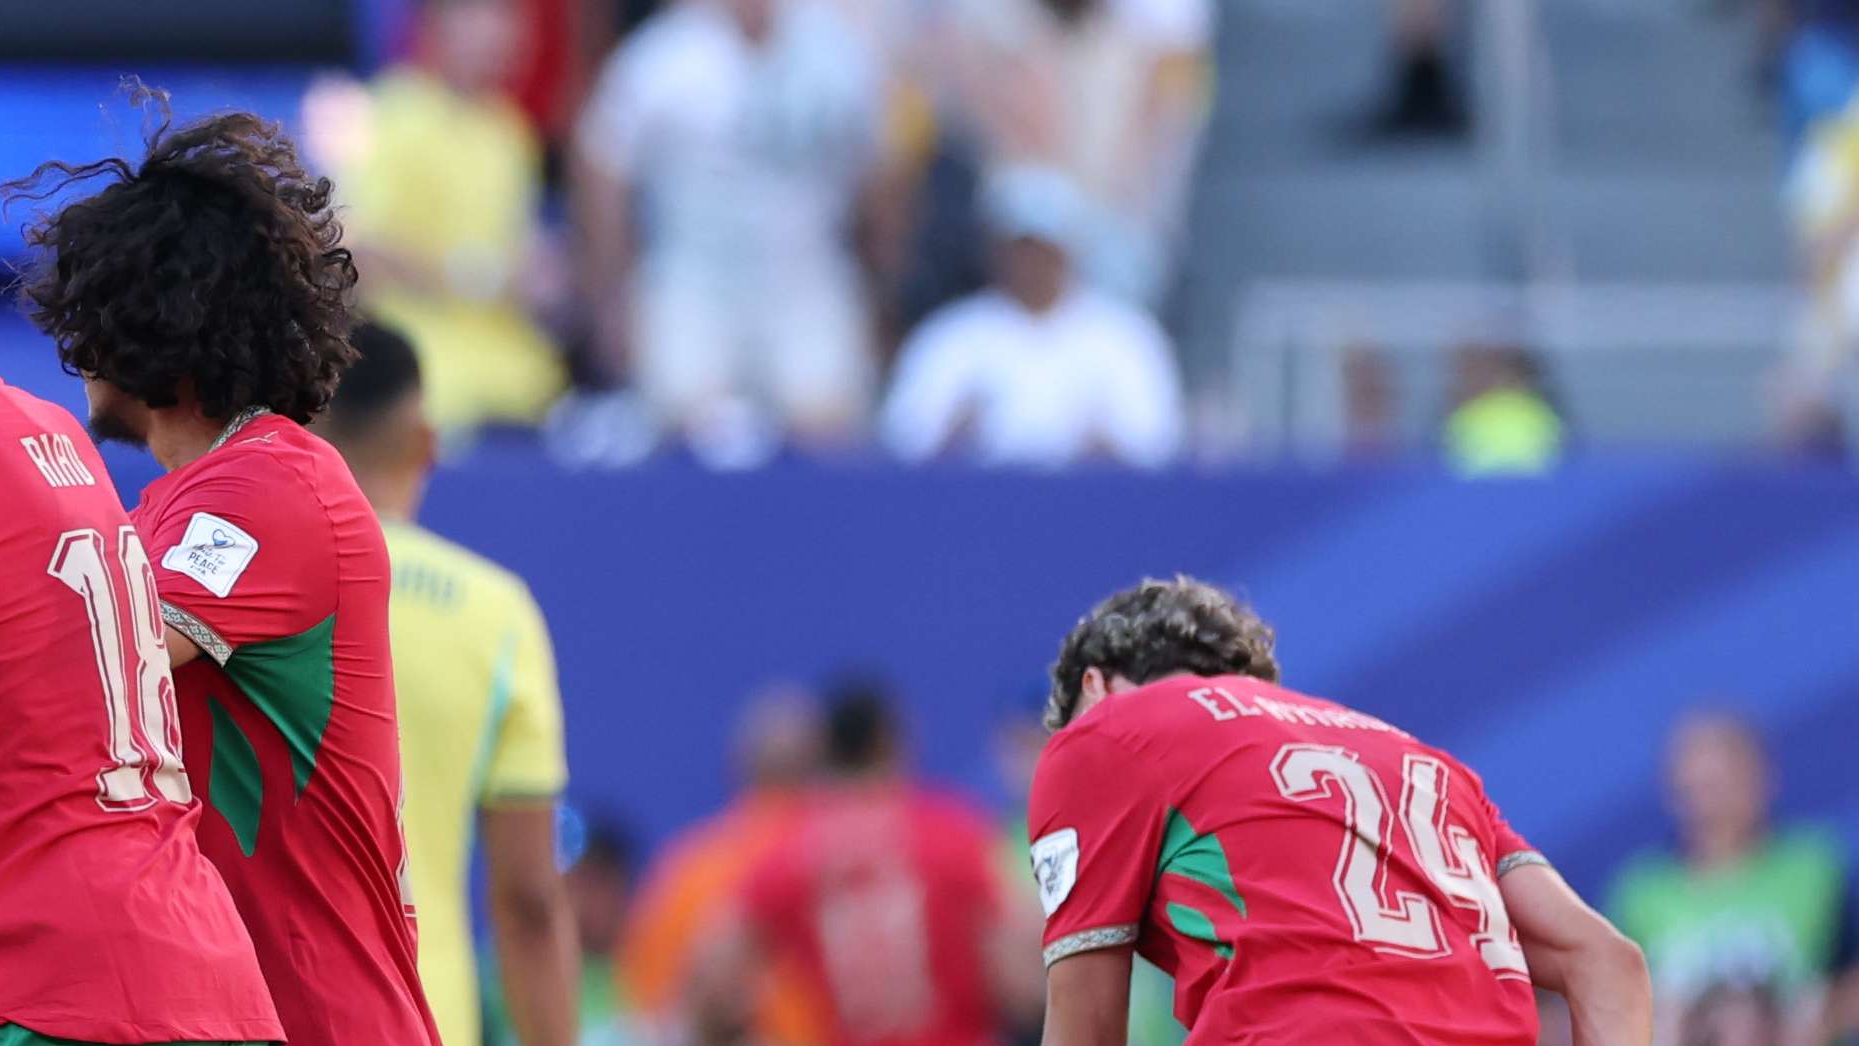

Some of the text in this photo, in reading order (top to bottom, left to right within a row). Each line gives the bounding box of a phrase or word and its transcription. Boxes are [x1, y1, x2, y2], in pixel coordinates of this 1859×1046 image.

[19, 433, 96, 487] RIAD
[47, 525, 195, 812] 18
[1187, 687, 1262, 721] EL
[1269, 742, 1532, 984] 24
